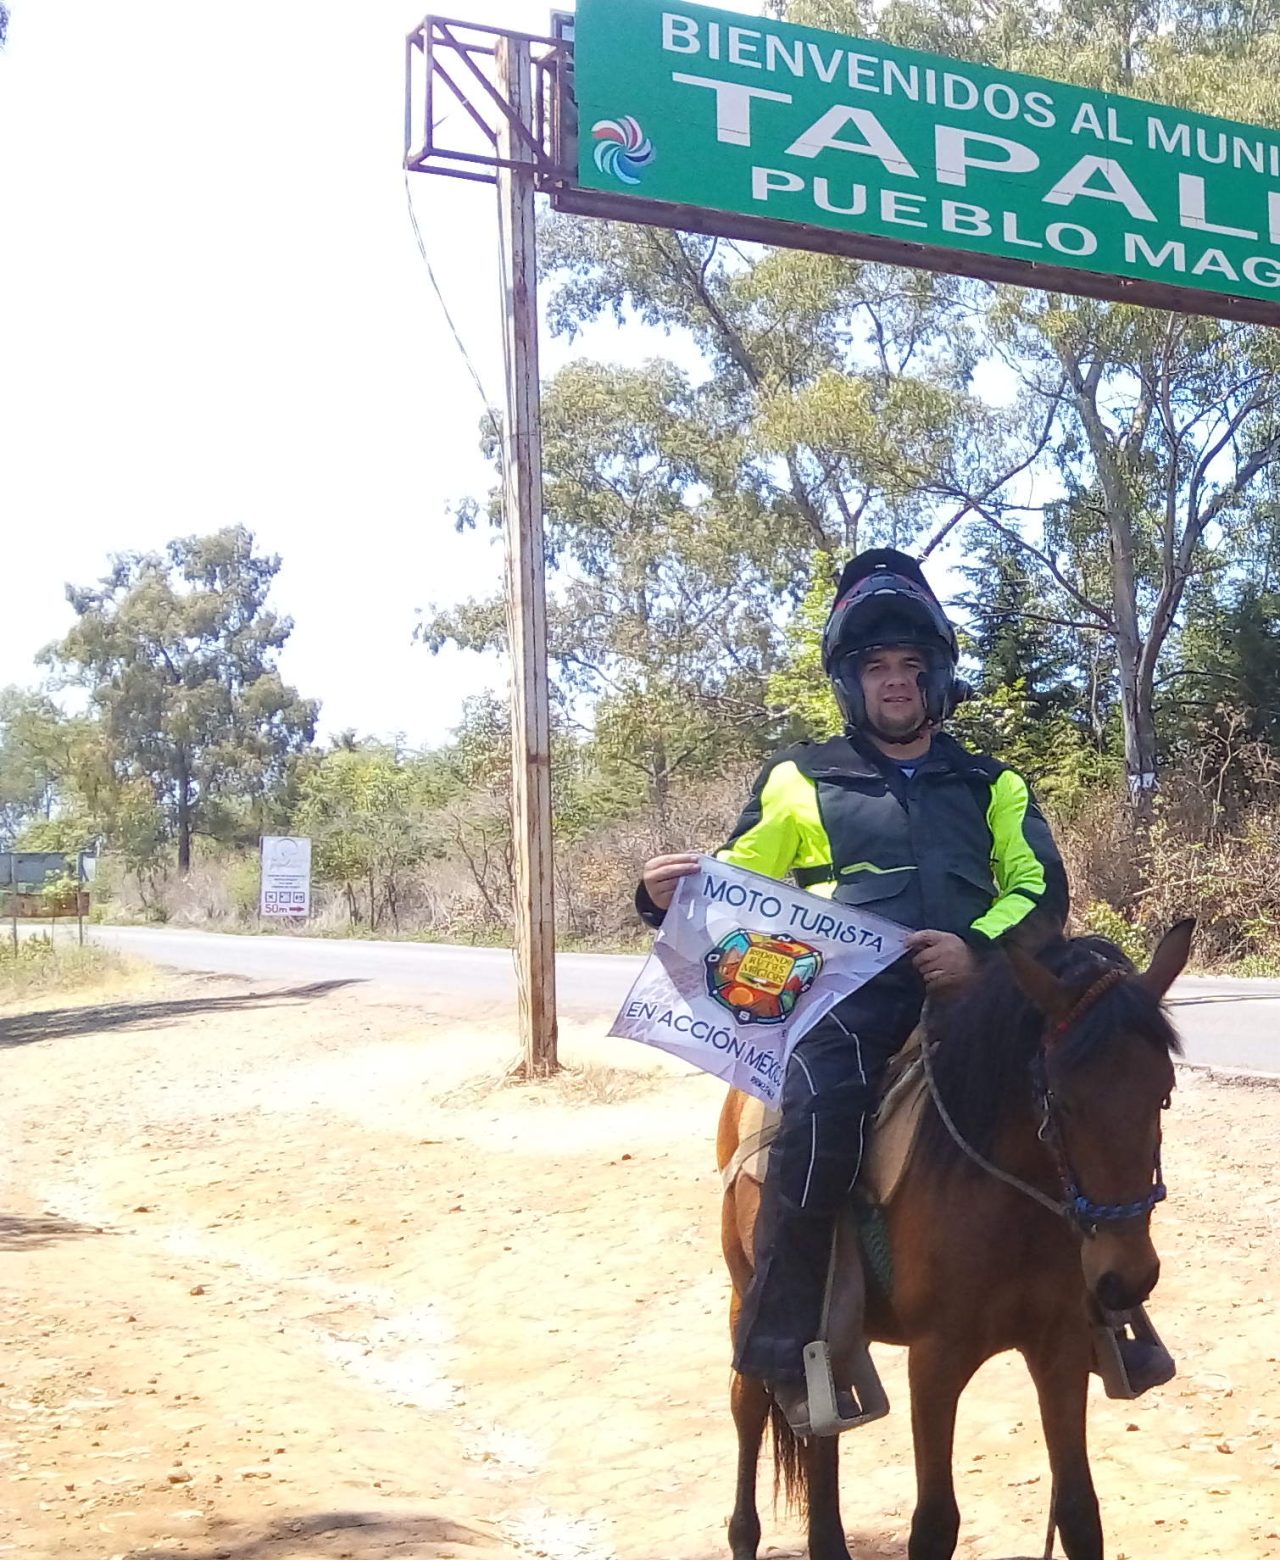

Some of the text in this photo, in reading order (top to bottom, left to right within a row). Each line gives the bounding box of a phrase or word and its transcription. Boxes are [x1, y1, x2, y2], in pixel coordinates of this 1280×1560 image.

[661, 12, 1056, 128] BIENVENIDOS
[1070, 102, 1134, 146] AL
[751, 166, 1098, 256] PUEBLO
[703, 875, 884, 953] MOTO TURISTA
[626, 1001, 658, 1019] EN
[657, 1010, 747, 1059] ACCIÓN
